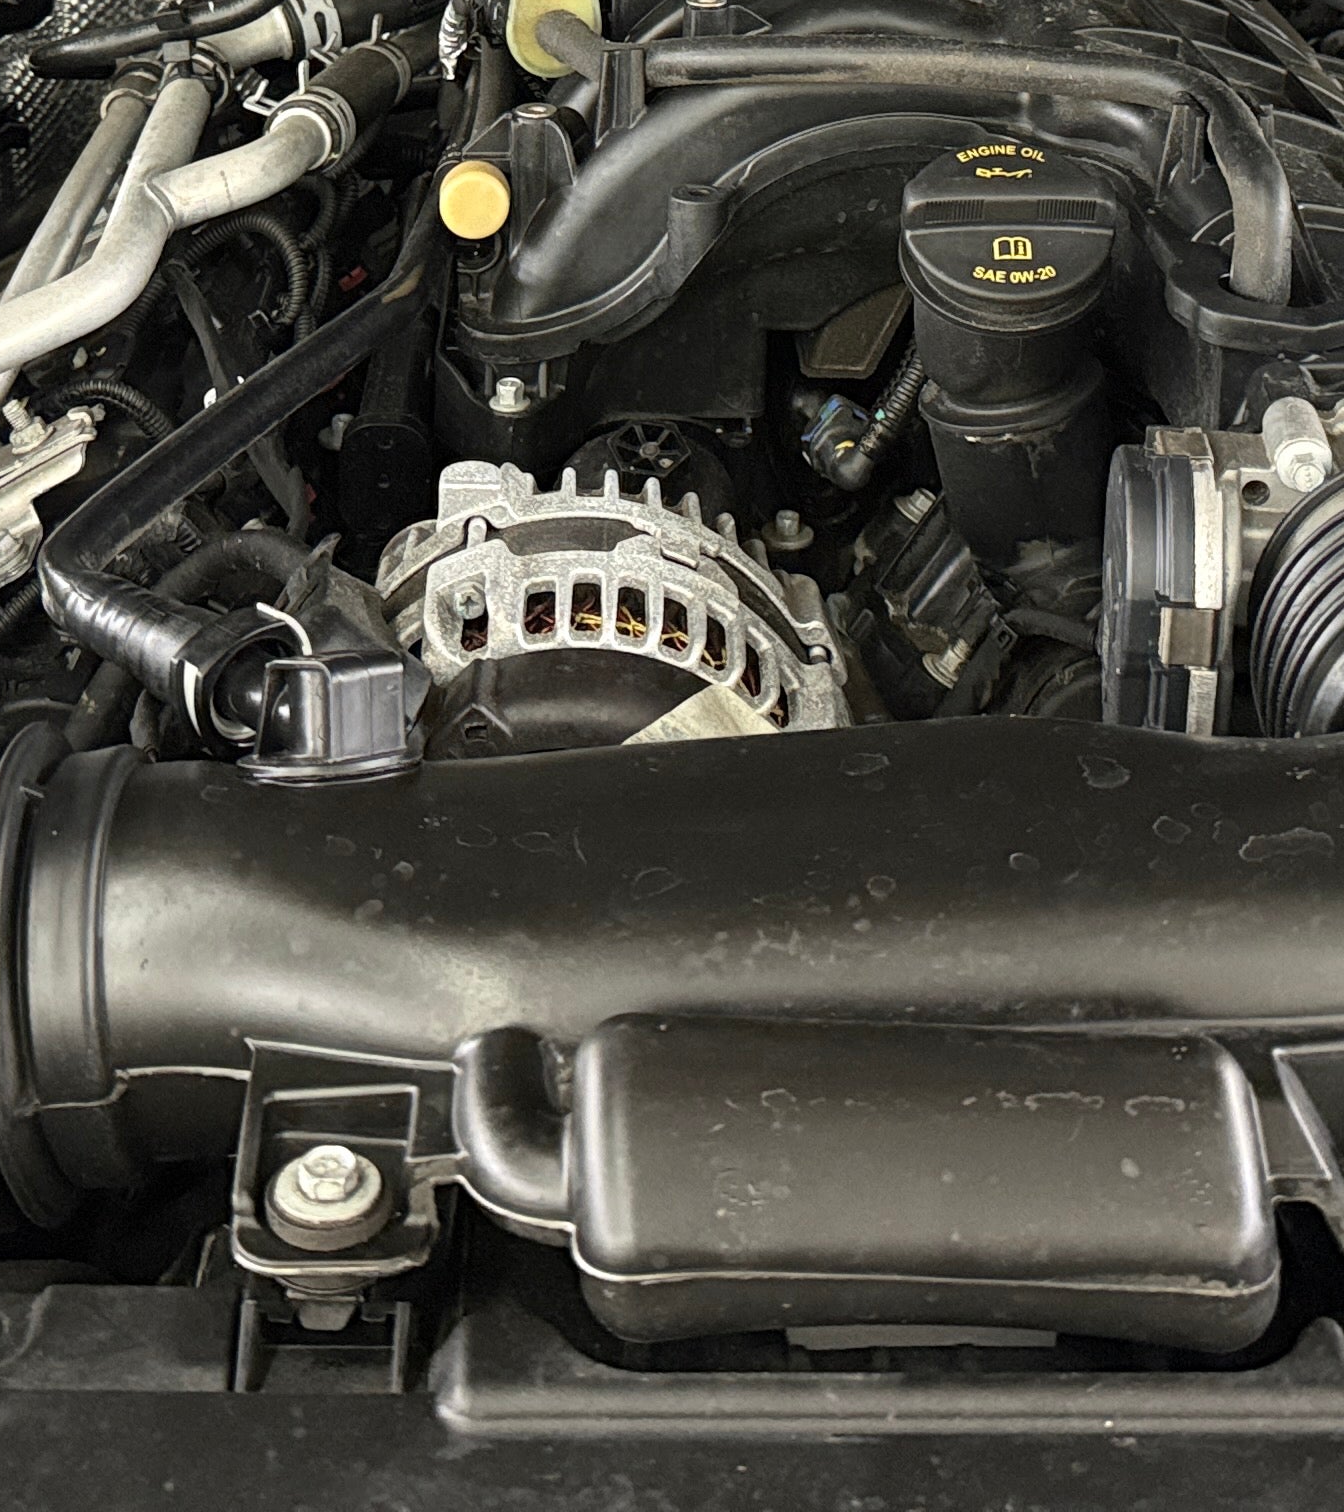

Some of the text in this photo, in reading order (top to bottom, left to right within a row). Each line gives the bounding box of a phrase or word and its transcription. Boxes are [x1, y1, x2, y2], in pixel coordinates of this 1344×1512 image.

[956, 144, 1046, 163] ENGINE OIL
[972, 265, 1057, 284] SAE 0W-20
